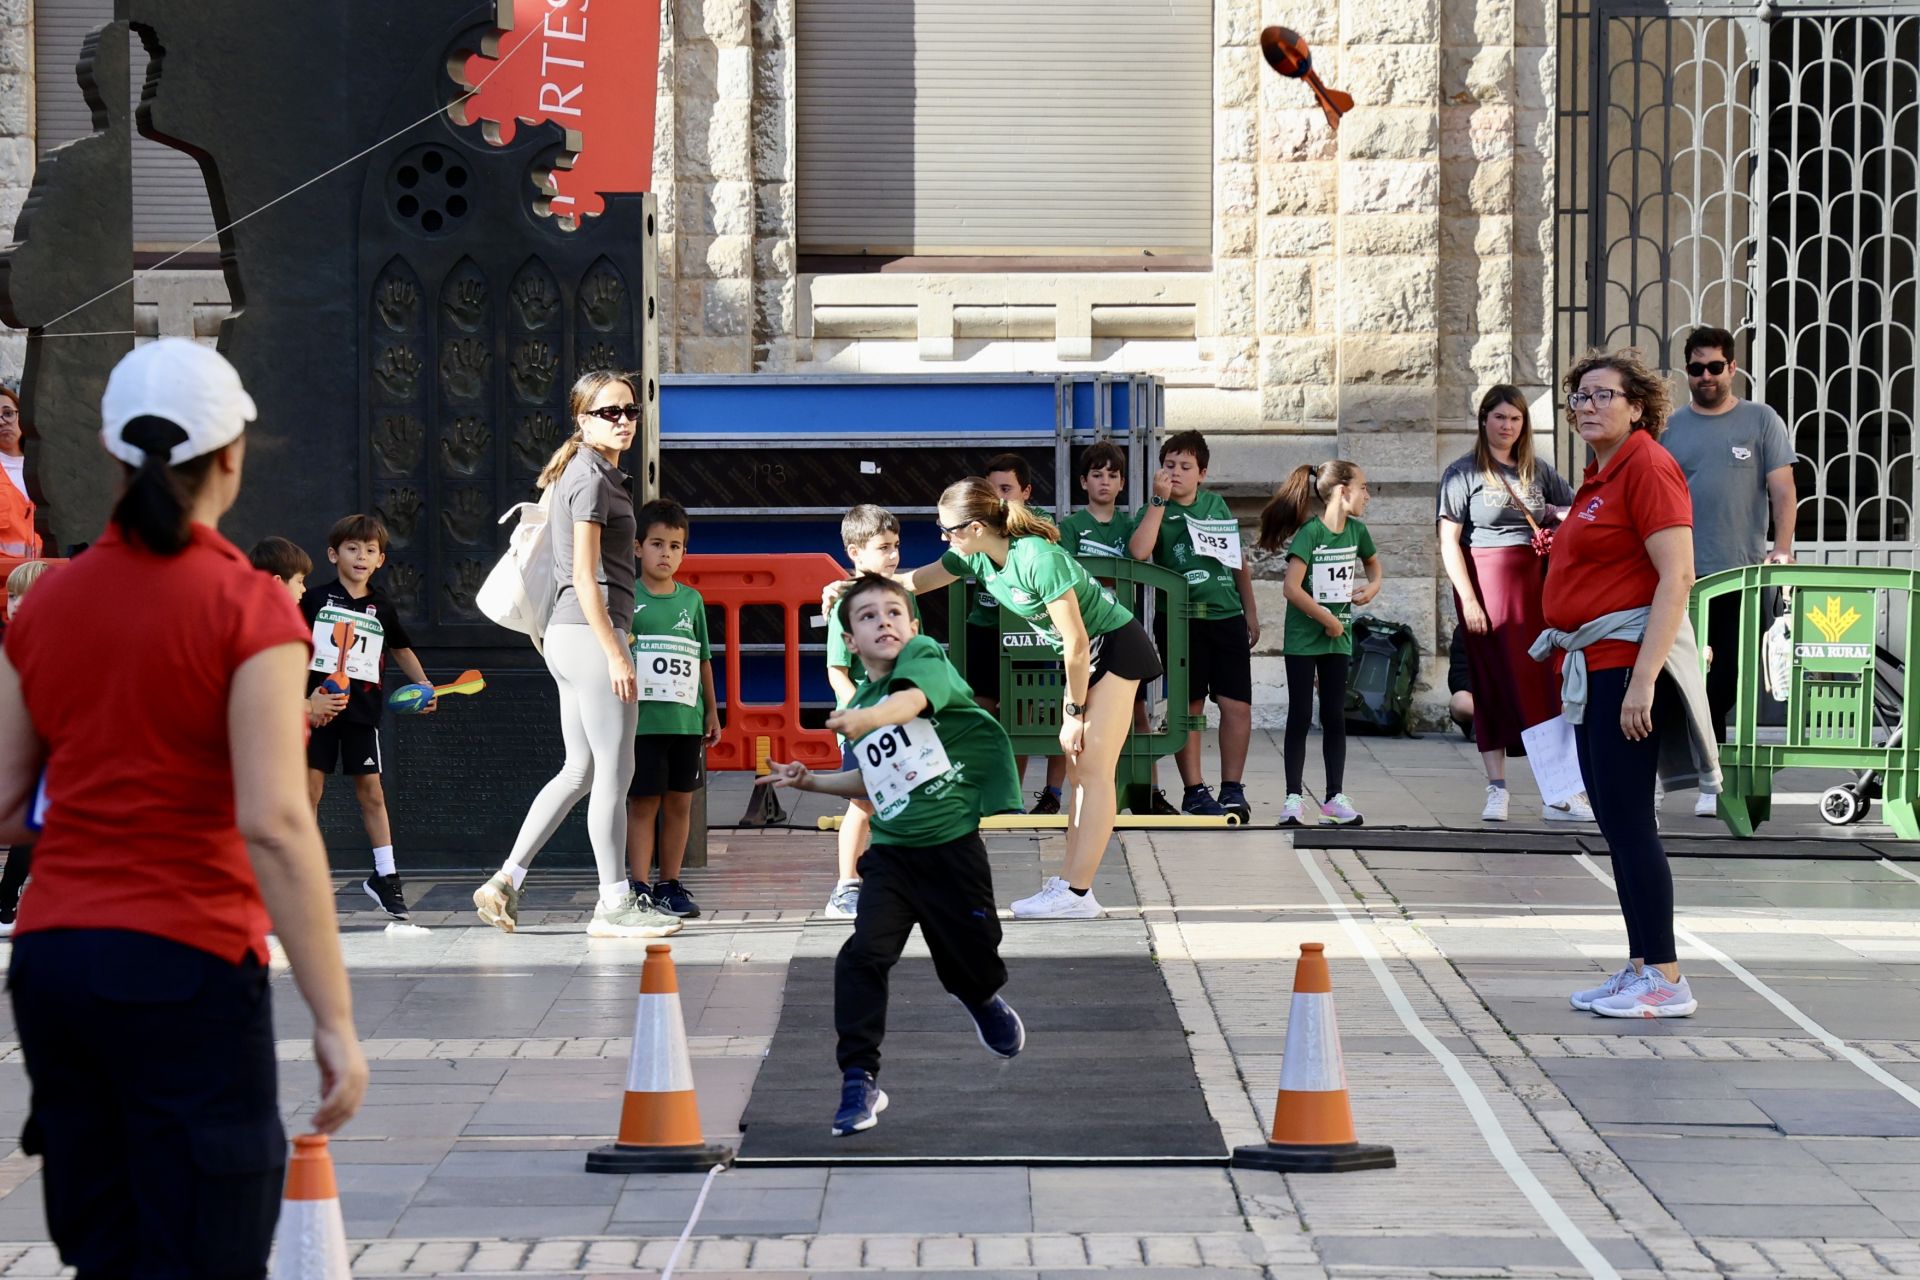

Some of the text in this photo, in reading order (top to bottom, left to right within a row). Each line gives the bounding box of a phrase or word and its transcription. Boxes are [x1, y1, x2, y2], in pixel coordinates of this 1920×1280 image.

[1328, 566, 1353, 581] 147
[331, 633, 367, 653] 71
[1003, 636, 1033, 647] CAJA
[1795, 645, 1871, 658] CAJA RURAL
[652, 657, 692, 677] 053
[866, 725, 912, 767] 091
